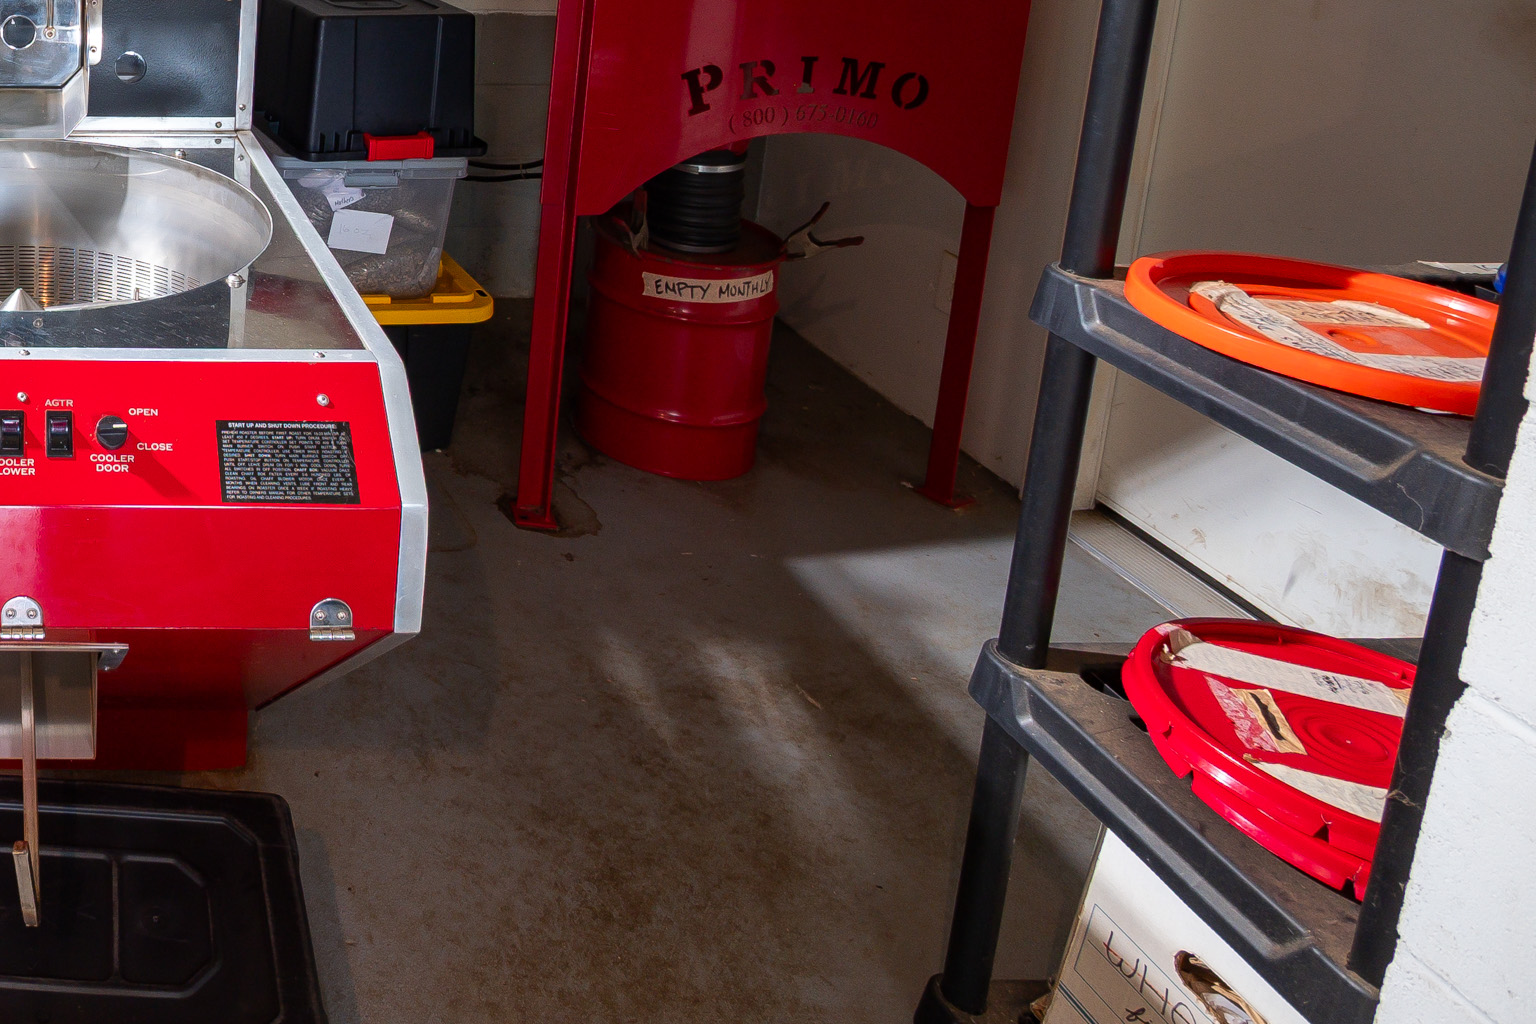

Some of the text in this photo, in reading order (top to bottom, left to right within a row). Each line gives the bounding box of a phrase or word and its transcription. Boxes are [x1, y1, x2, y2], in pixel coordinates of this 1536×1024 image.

[680, 56, 930, 117] PRIMO
[654, 276, 772, 300] EMPTY MONTHLY
[44, 399, 74, 407] AGTR
[128, 408, 159, 416] OPEN
[136, 442, 174, 451] CLOSE
[89, 454, 135, 463] COOLER
[95, 464, 129, 473] DOOR
